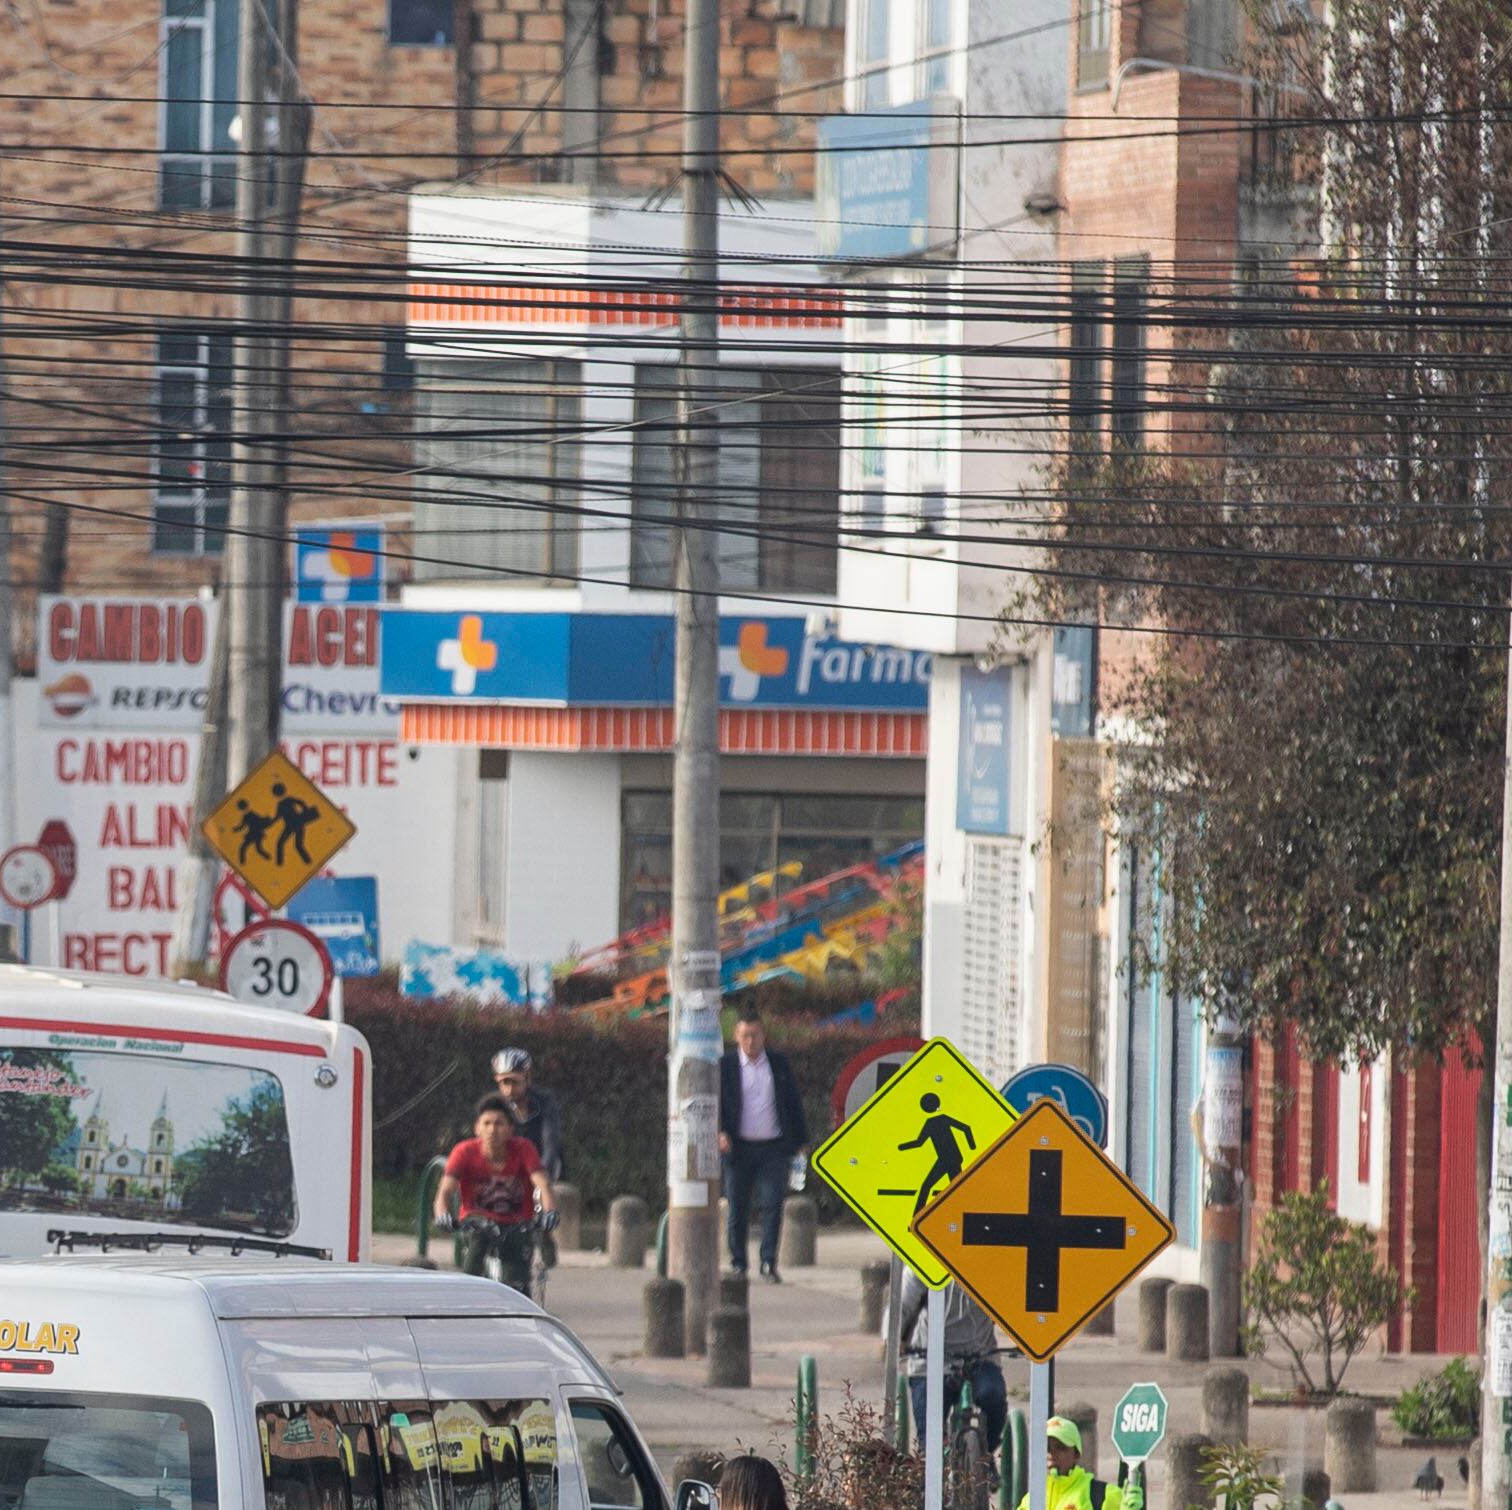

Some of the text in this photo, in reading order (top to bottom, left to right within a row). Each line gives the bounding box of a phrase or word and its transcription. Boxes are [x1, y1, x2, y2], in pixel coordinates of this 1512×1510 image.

[50, 602, 206, 664] CAMBIO
[58, 735, 399, 787] CAMBIO CEITE
[65, 933, 173, 978] RECT
[251, 957, 299, 996] 30
[48, 1034, 184, 1053] Operacion Nacional
[1120, 1405, 1159, 1433] SIGA
